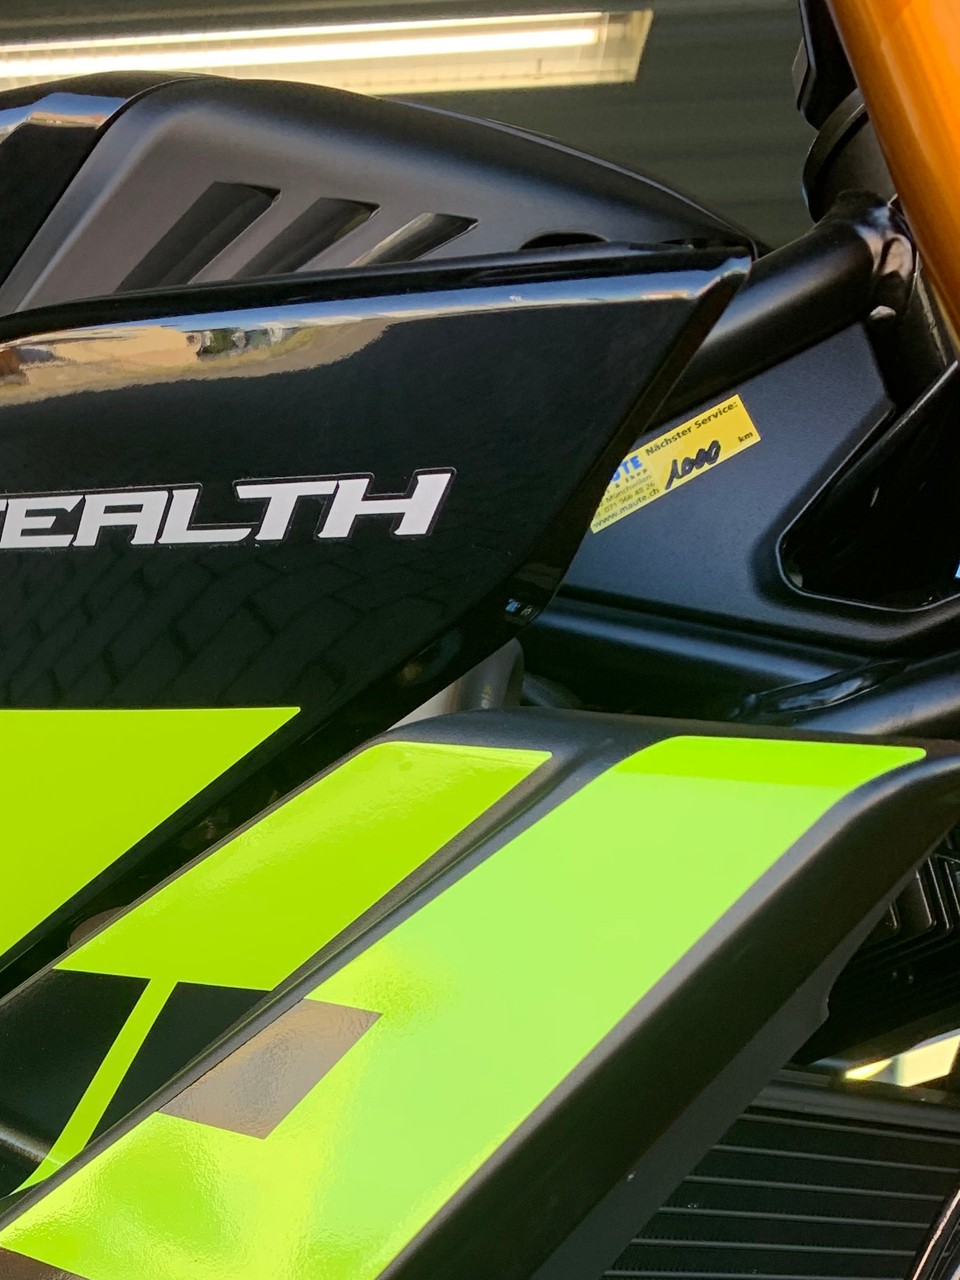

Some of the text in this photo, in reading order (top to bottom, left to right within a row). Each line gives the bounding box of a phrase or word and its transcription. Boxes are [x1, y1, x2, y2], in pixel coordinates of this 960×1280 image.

[645, 402, 738, 455] Nächster Service:
[738, 431, 754, 443] km
[593, 488, 660, 528] www.maute.ch
